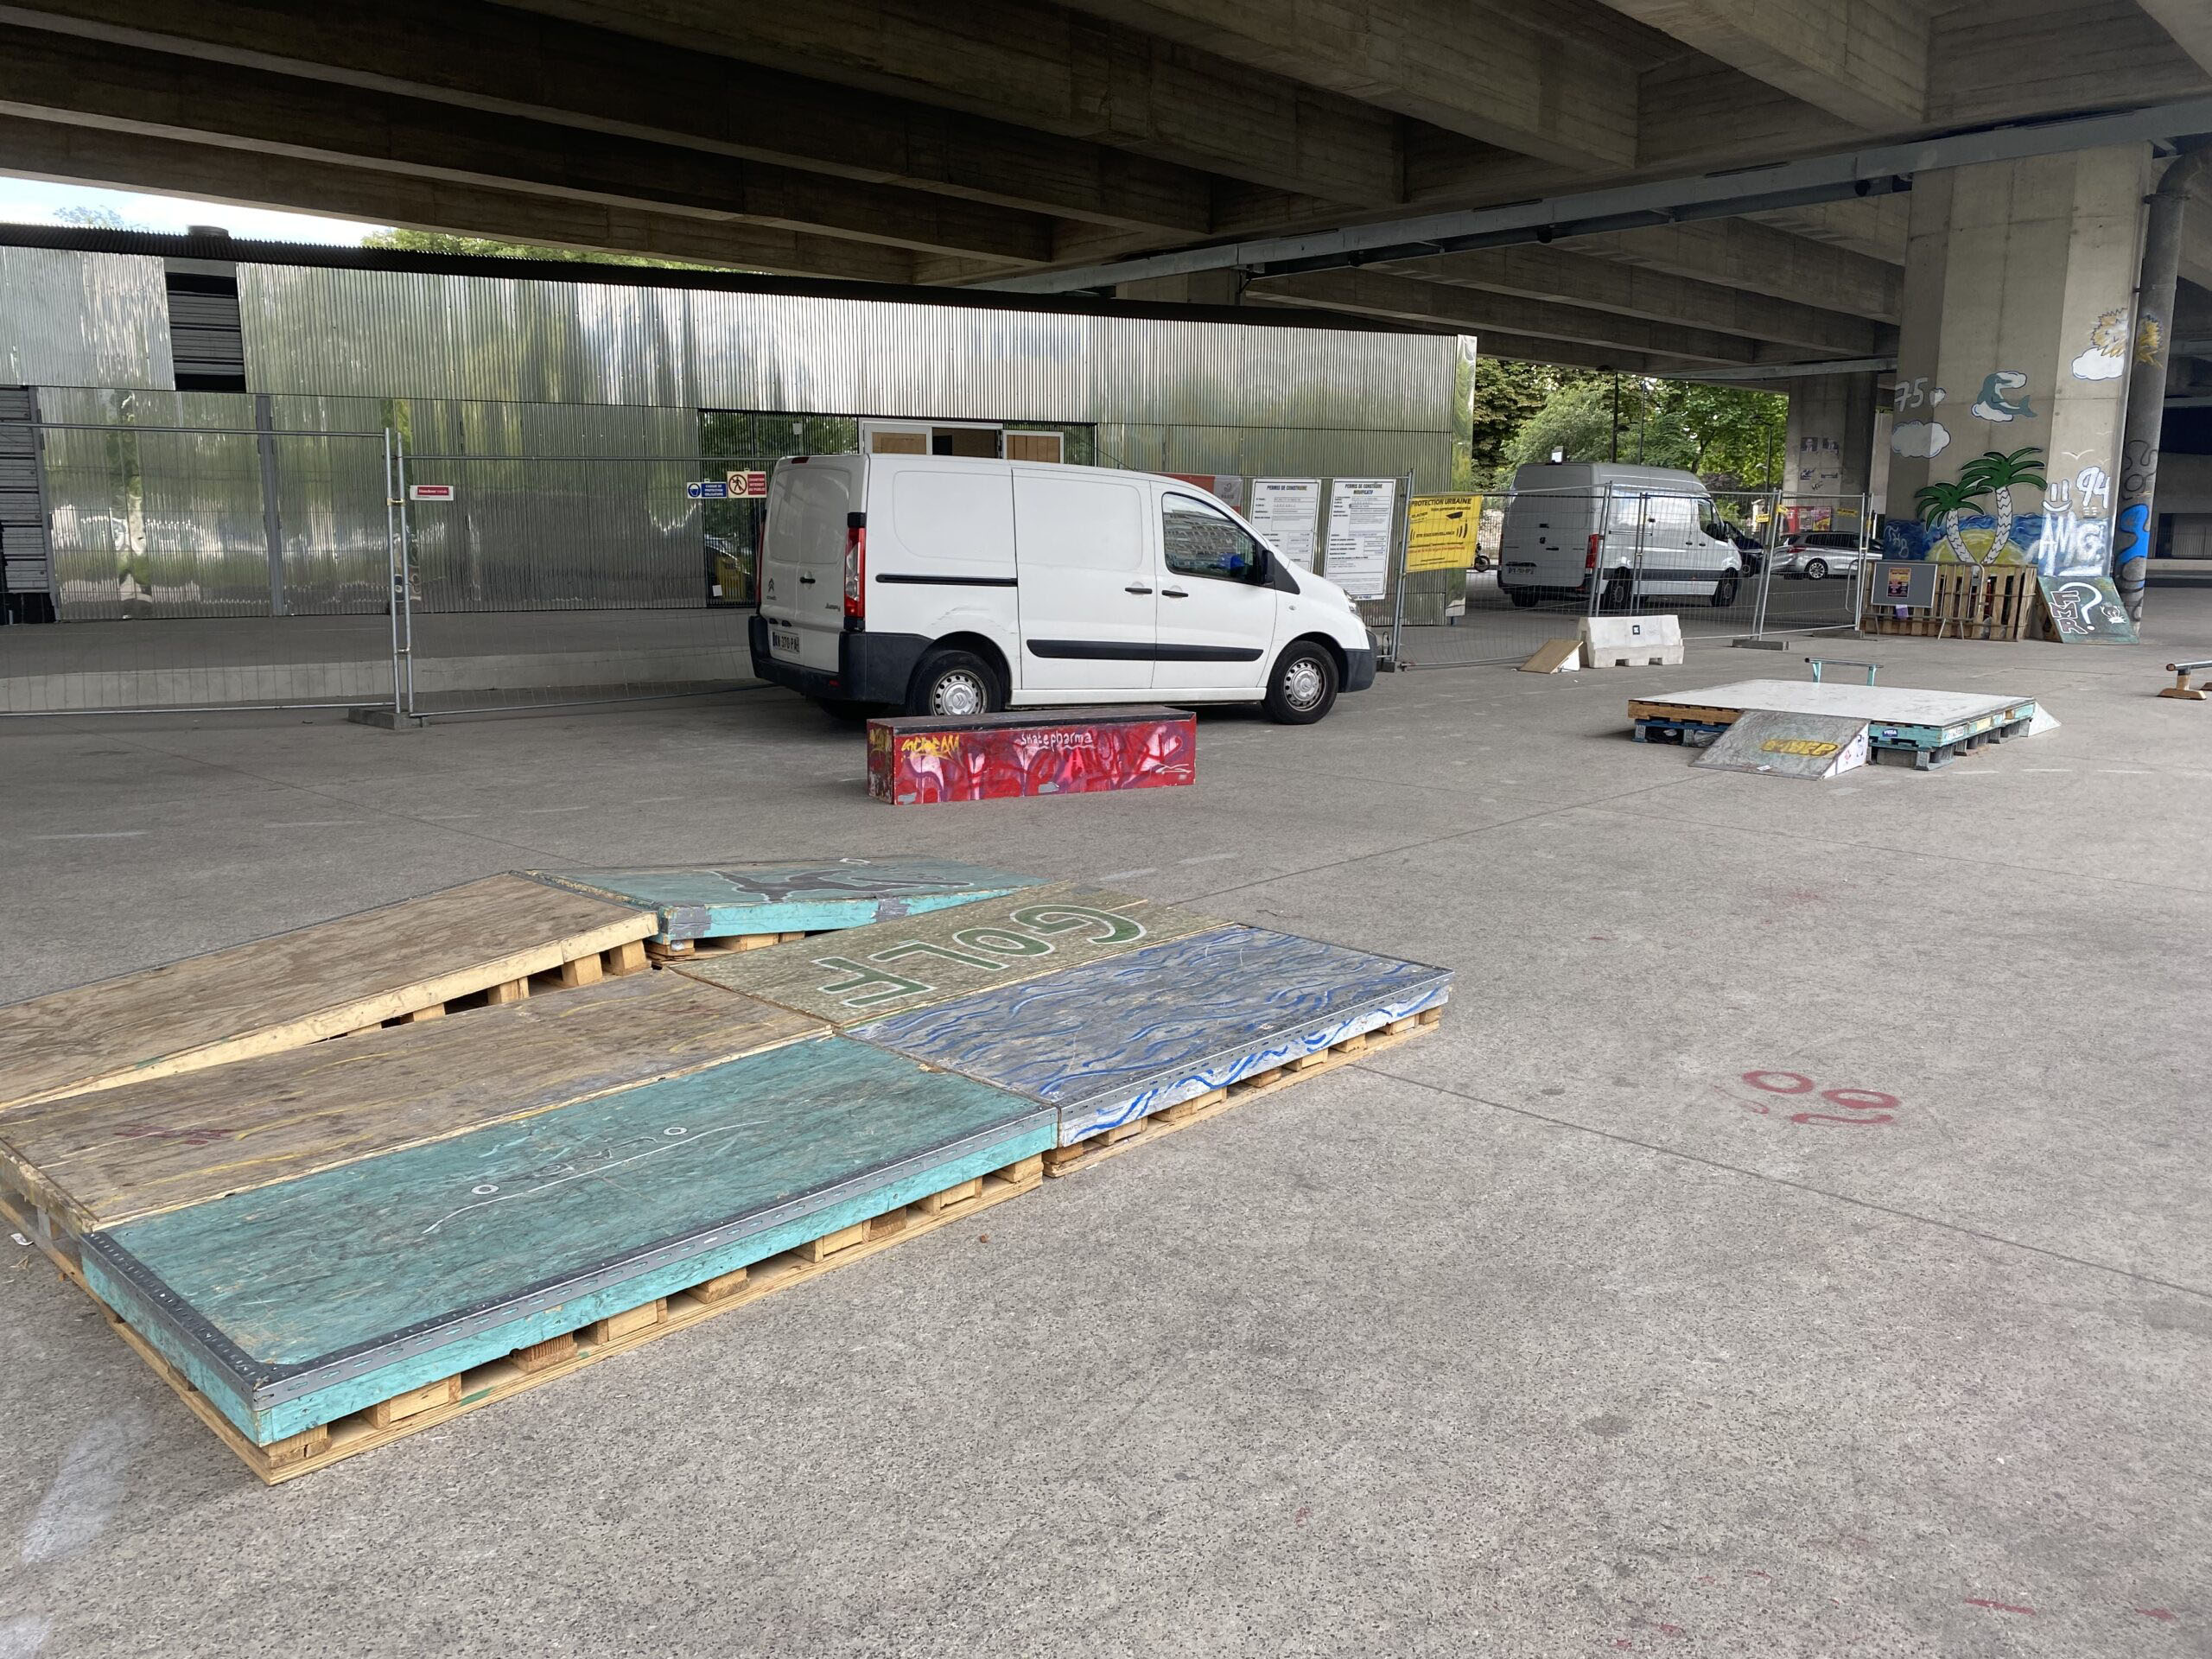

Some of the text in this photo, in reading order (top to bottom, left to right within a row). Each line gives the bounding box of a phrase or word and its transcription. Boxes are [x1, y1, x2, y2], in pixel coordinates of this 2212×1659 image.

[1411, 499, 1444, 507] PROTECTION
[2076, 467, 2110, 509] 94
[810, 903, 1147, 1008] GOLF
